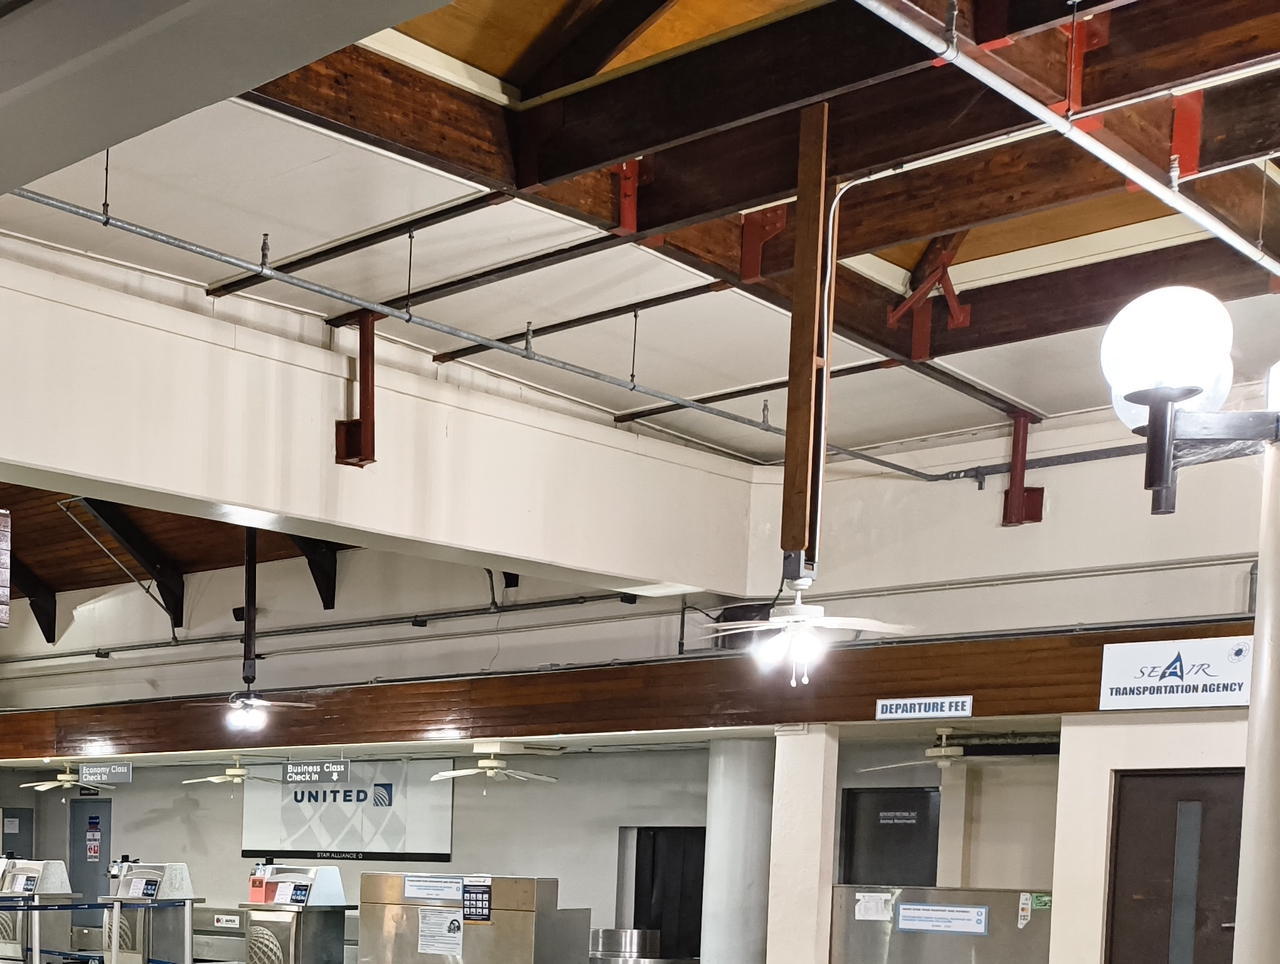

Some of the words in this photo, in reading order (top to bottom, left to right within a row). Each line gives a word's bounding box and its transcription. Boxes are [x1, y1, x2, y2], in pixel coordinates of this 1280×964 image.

[1134, 651, 1219, 682] SEAIR
[1109, 684, 1199, 697] TRANSPORTATION
[1201, 682, 1244, 693] AGENCY
[880, 702, 946, 714] DEPARTURE
[948, 701, 967, 712] FEE
[82, 766, 110, 774] Economy
[111, 765, 128, 773] Class
[287, 764, 321, 773] Business
[323, 763, 345, 772] Class
[286, 773, 311, 781] Check
[312, 773, 319, 781] In
[293, 789, 368, 803] UNITED
